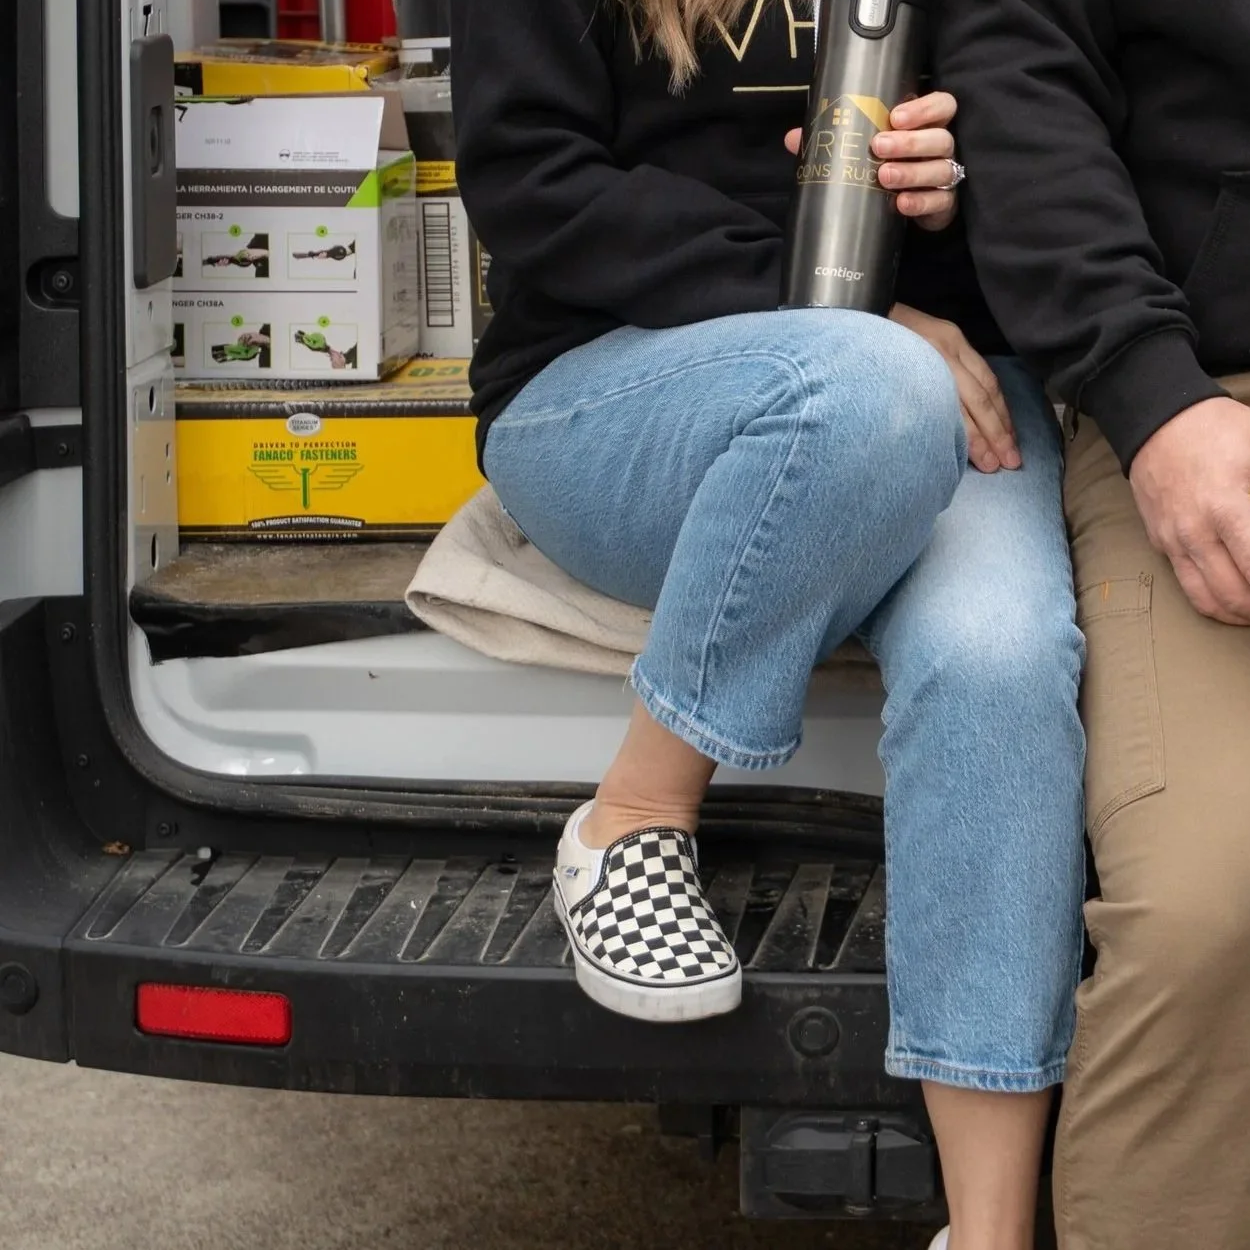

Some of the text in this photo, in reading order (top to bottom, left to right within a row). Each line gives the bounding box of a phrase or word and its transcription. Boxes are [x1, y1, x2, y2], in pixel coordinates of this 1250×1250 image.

[800, 130, 885, 164] VRE
[188, 184, 248, 194] HERRAMIENTA
[254, 184, 311, 194] CHARGEMENT
[313, 185, 326, 194] DE
[175, 212, 193, 220] GER
[814, 266, 861, 281] contigo
[171, 300, 195, 308] NGER
[253, 449, 357, 461] FANACO FASTENERS
